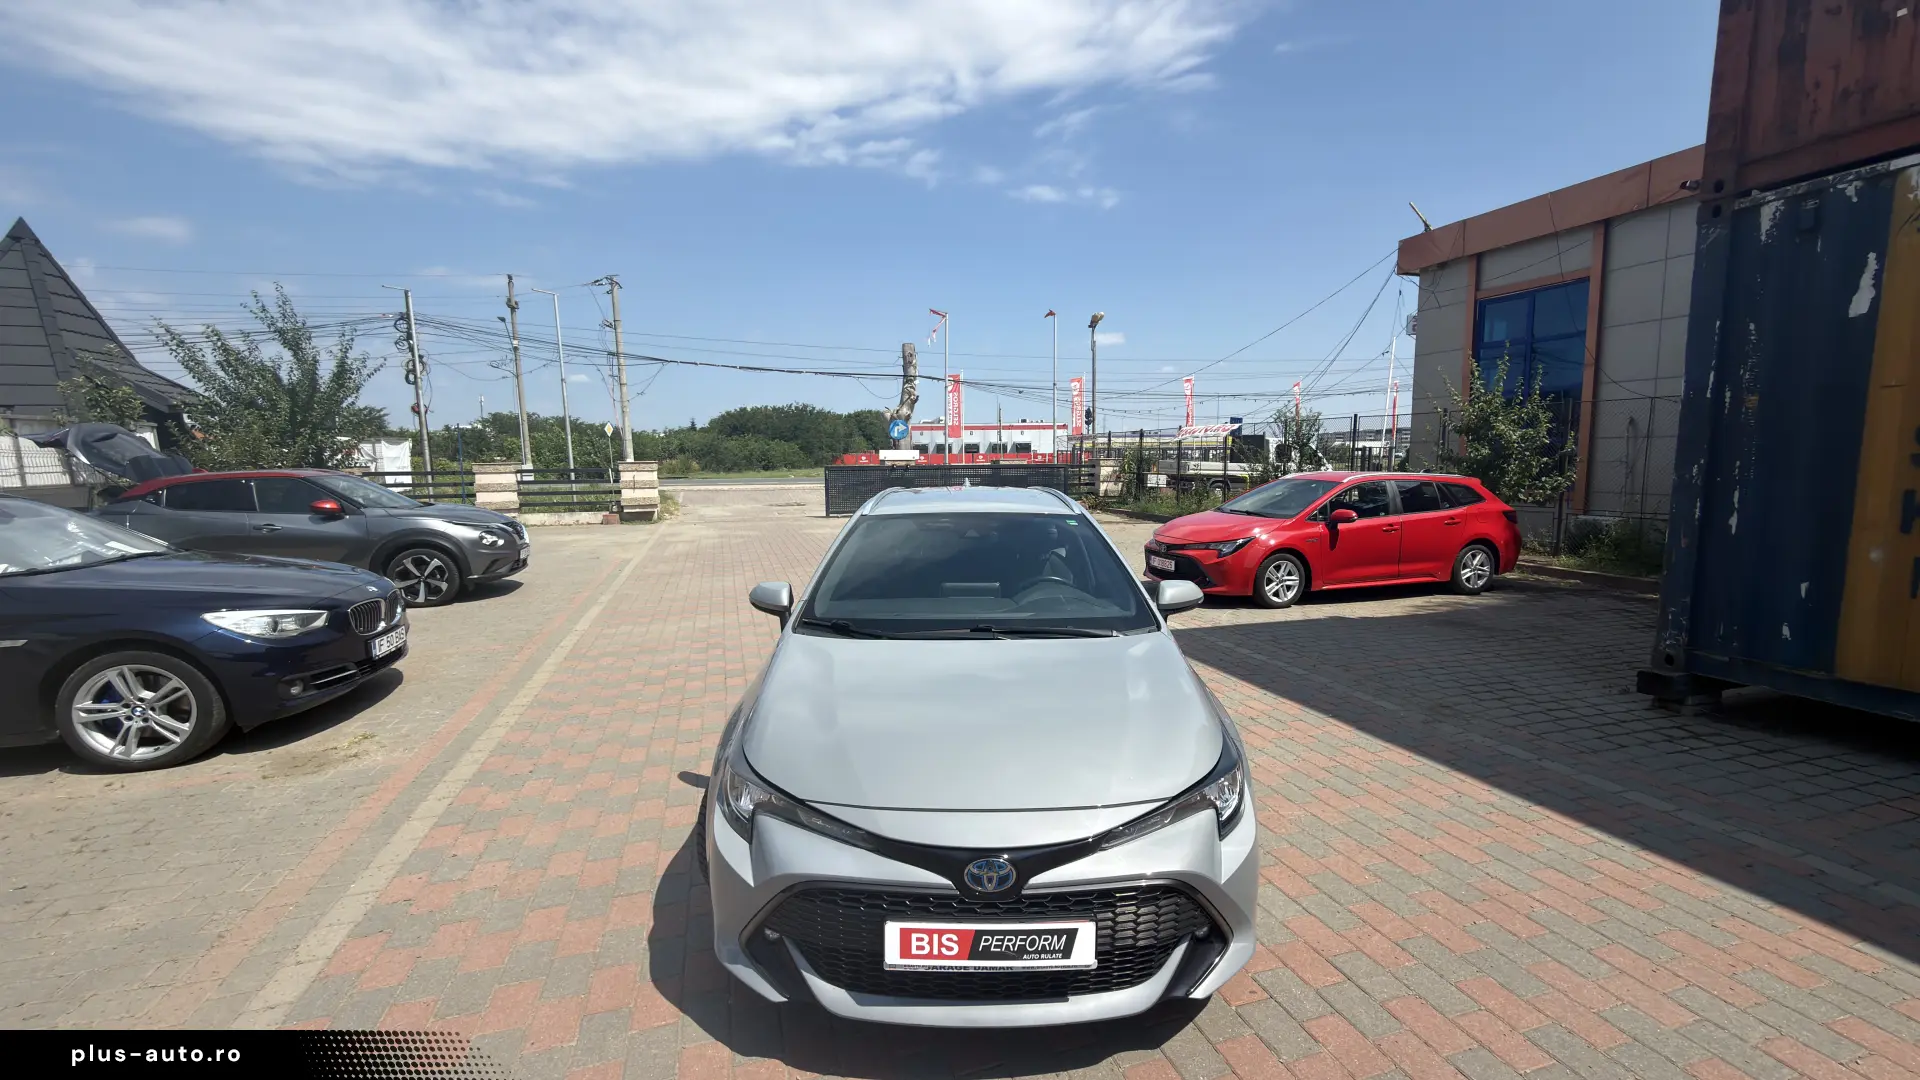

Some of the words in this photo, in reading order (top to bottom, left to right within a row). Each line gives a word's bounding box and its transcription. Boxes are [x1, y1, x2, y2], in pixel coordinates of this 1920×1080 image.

[386, 634, 394, 648] 50
[911, 933, 959, 956] BIS
[978, 934, 1067, 951] PERFORM
